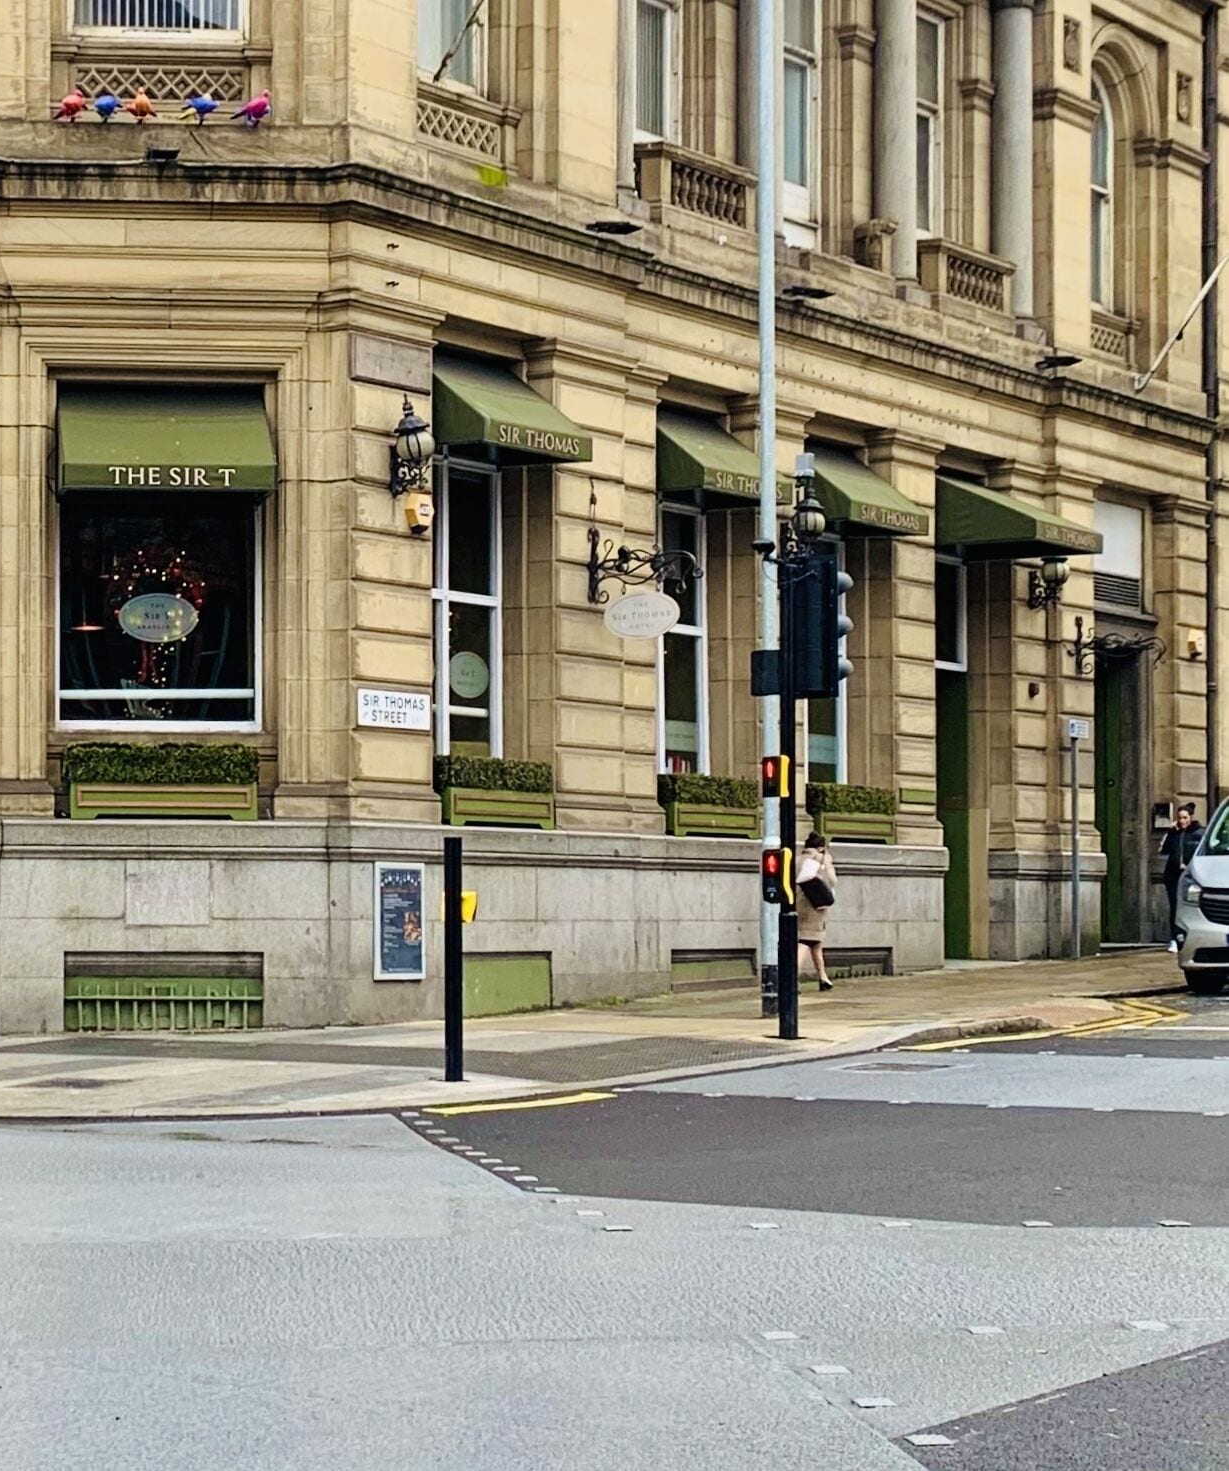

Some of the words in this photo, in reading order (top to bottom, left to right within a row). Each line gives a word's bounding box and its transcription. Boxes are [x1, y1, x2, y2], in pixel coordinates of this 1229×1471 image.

[499, 424, 521, 444] SIR
[526, 430, 580, 455] THOMAS
[109, 467, 161, 485] THE
[170, 467, 210, 486] SIR
[218, 468, 236, 487] T
[716, 471, 734, 490] SIR
[737, 476, 783, 500] THOS
[861, 505, 878, 521] SIR
[881, 508, 920, 529] THOMAS
[1045, 525, 1060, 539] SIR
[1061, 527, 1096, 548] THOMAS
[362, 694, 380, 708] SIR
[384, 696, 426, 711] THOMAS
[371, 709, 407, 724] STREET
